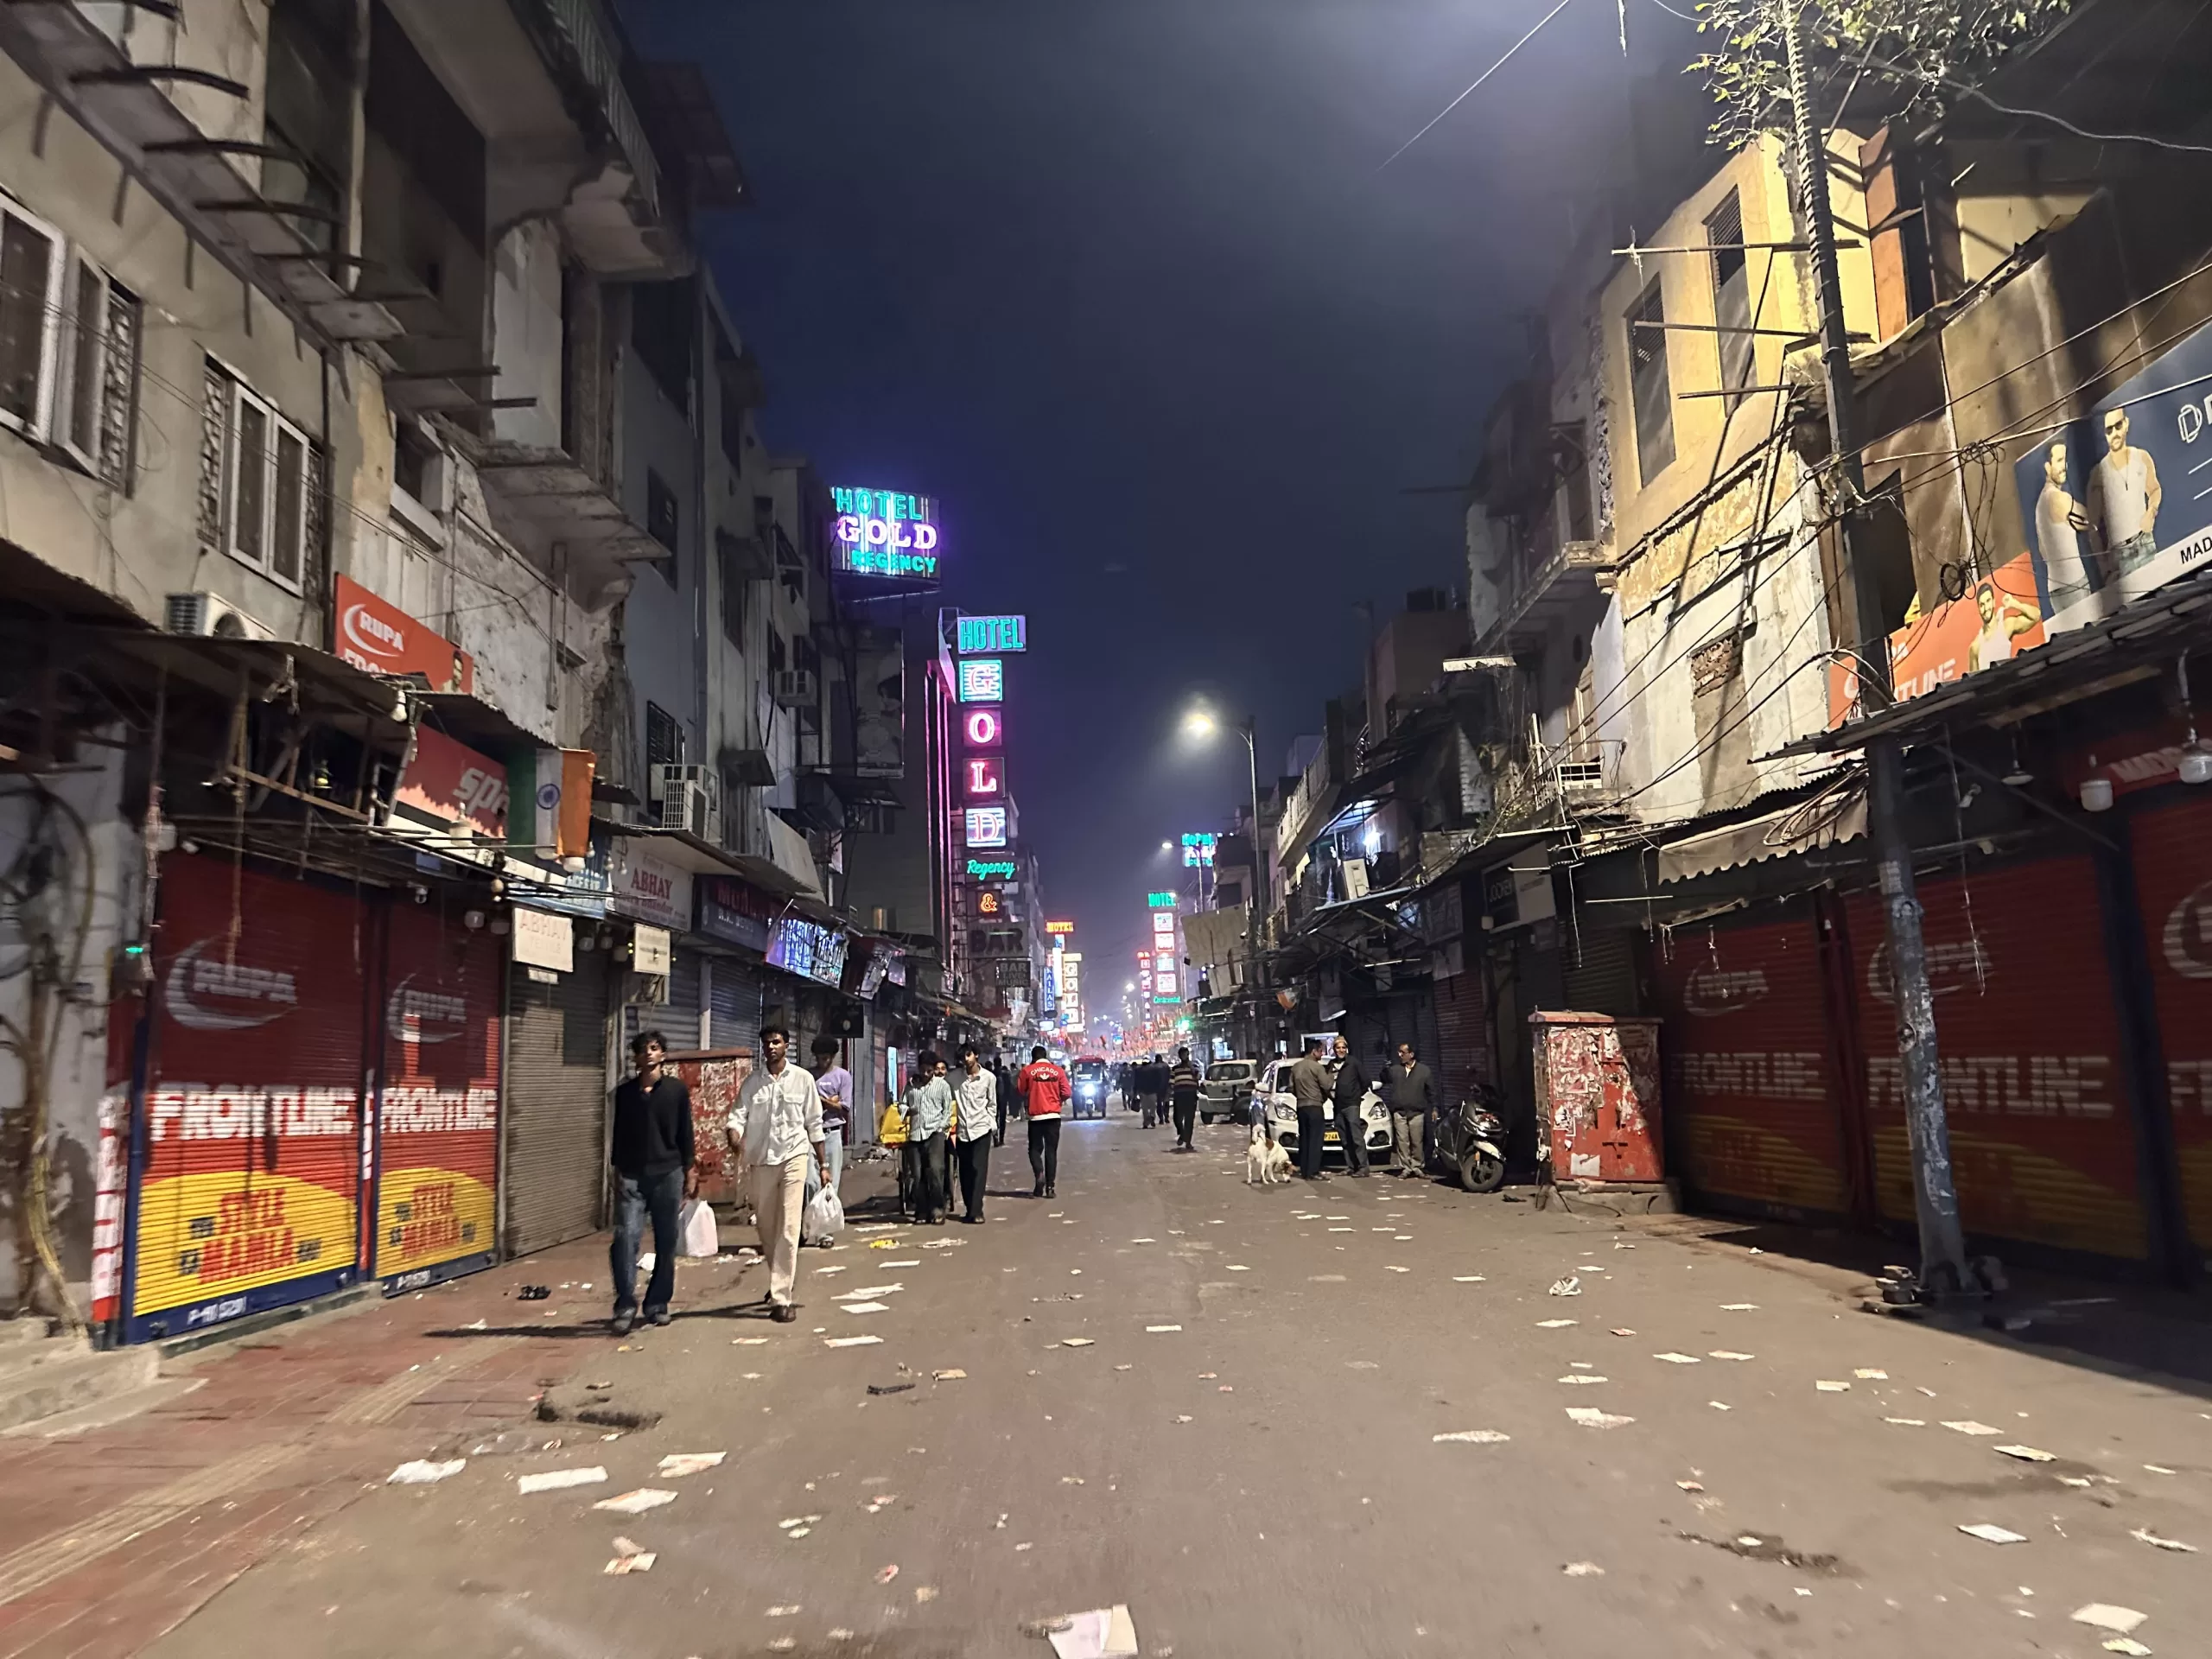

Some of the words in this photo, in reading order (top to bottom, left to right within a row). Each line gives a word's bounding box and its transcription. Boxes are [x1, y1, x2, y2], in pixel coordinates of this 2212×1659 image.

[836, 486, 922, 520] HOTEL
[836, 515, 938, 550] GOLD
[851, 550, 937, 573] REGENCY
[359, 610, 404, 652] RUPA
[960, 618, 1024, 650] HOTEL
[631, 868, 673, 900] ABHAY
[966, 859, 1015, 880] Regency
[980, 893, 998, 912] &
[520, 911, 569, 941] ABHAY
[971, 928, 1024, 953] BAR
[194, 959, 298, 1004] RUPA
[1000, 963, 1027, 972] BAR
[1697, 970, 1770, 998] RUPA
[404, 989, 467, 1023] RUPA
[1030, 1066, 1059, 1077] CHICAGO
[1672, 1052, 1827, 1100] FRONTLINE
[1868, 1056, 2113, 1118] FRNTLINE
[149, 1082, 357, 1141] FRONTLINE
[380, 1087, 498, 1135] FRONTLINE
